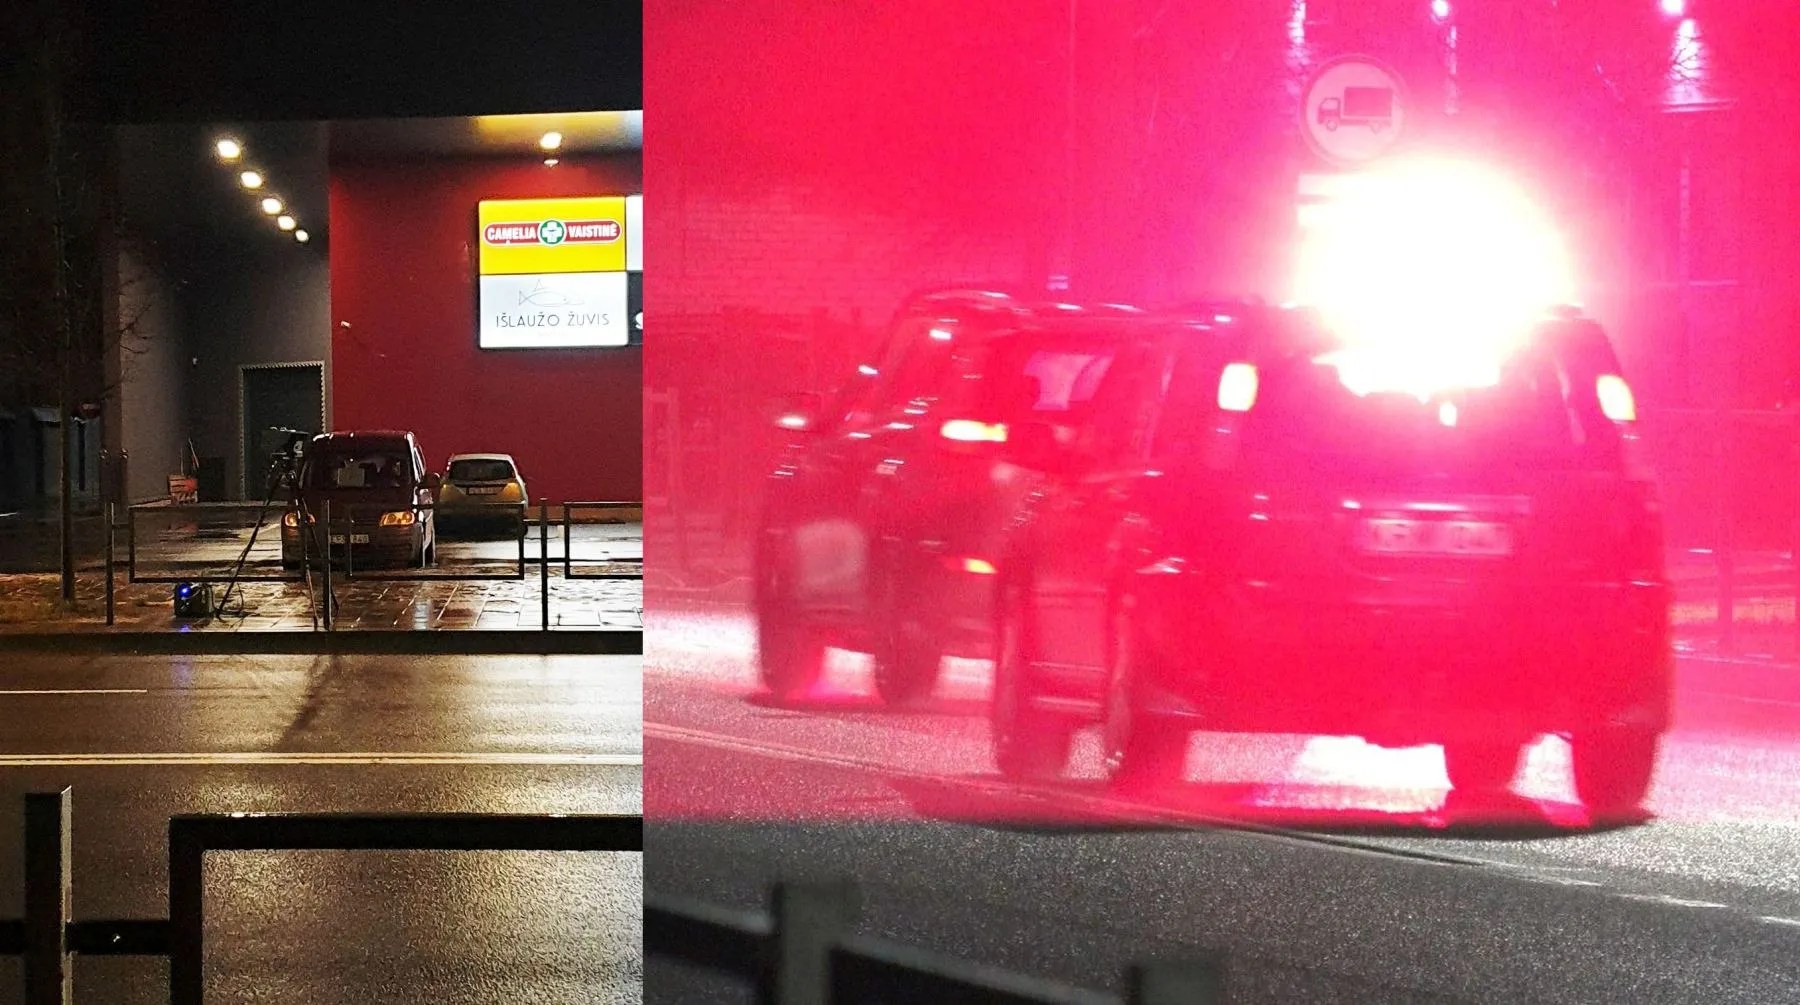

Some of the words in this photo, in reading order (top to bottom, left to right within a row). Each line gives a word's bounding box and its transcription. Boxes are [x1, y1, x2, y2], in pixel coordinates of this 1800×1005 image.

[487, 226, 536, 241] CAMELIA
[567, 223, 618, 238] VAISTINĖ
[496, 312, 560, 328] IŠLAUŽO
[567, 311, 610, 327] ŽUVIS
